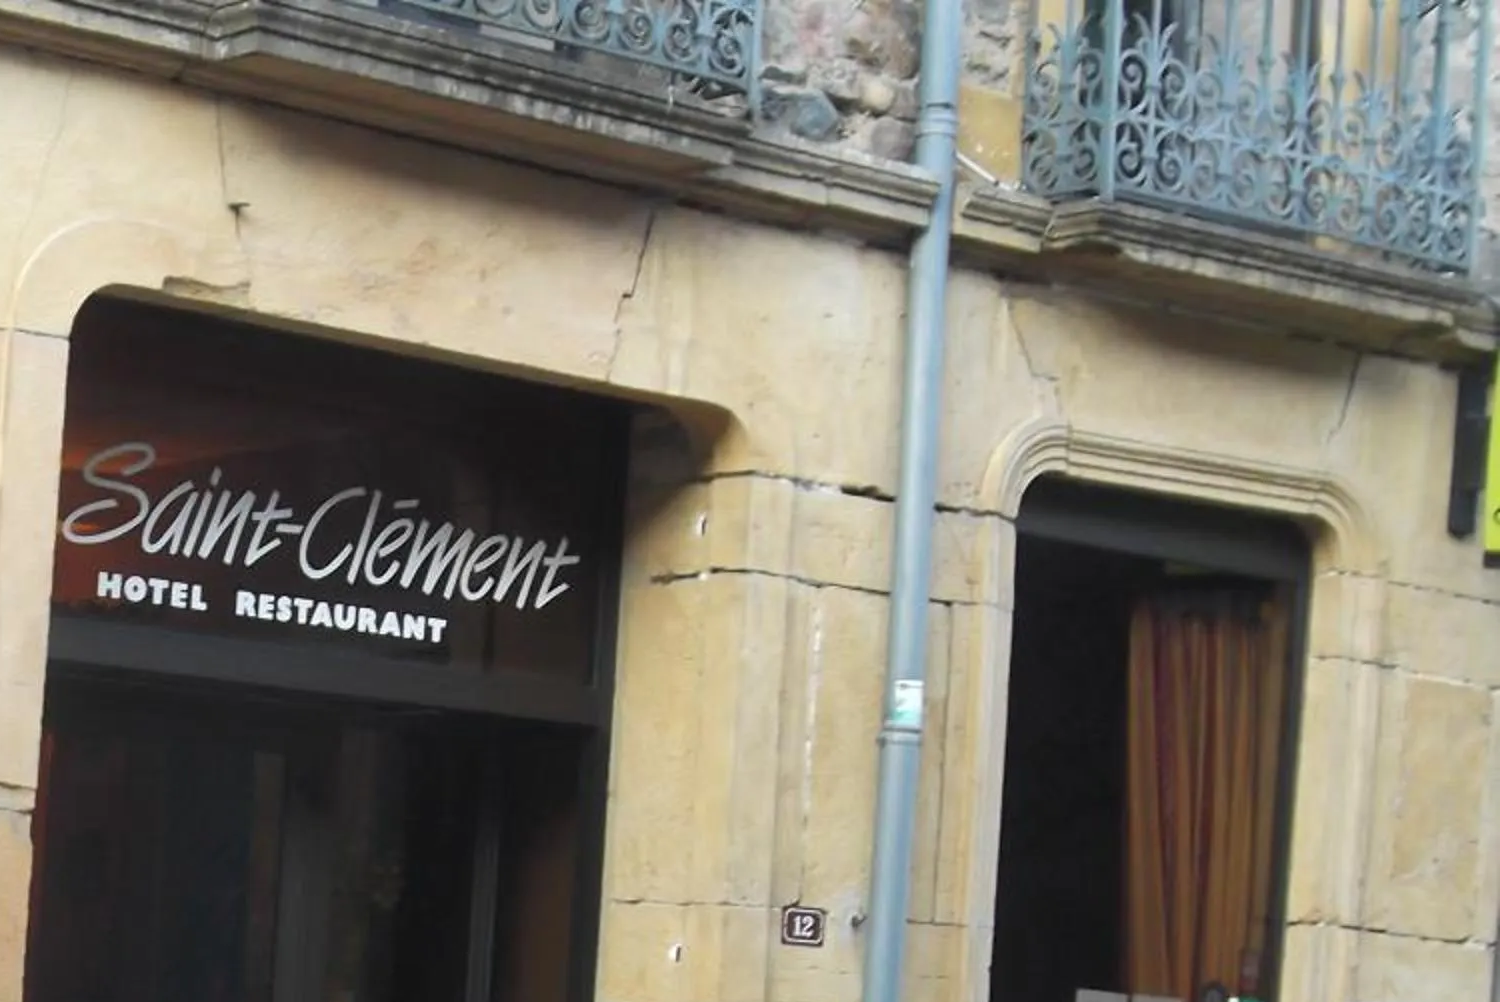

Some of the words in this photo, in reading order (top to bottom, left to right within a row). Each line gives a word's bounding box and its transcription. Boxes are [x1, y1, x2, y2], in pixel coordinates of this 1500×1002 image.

[62, 441, 580, 609] Saint-Clément
[97, 571, 208, 610] HOTEL
[235, 590, 447, 643] RESTAURANT
[793, 915, 815, 938] 12
